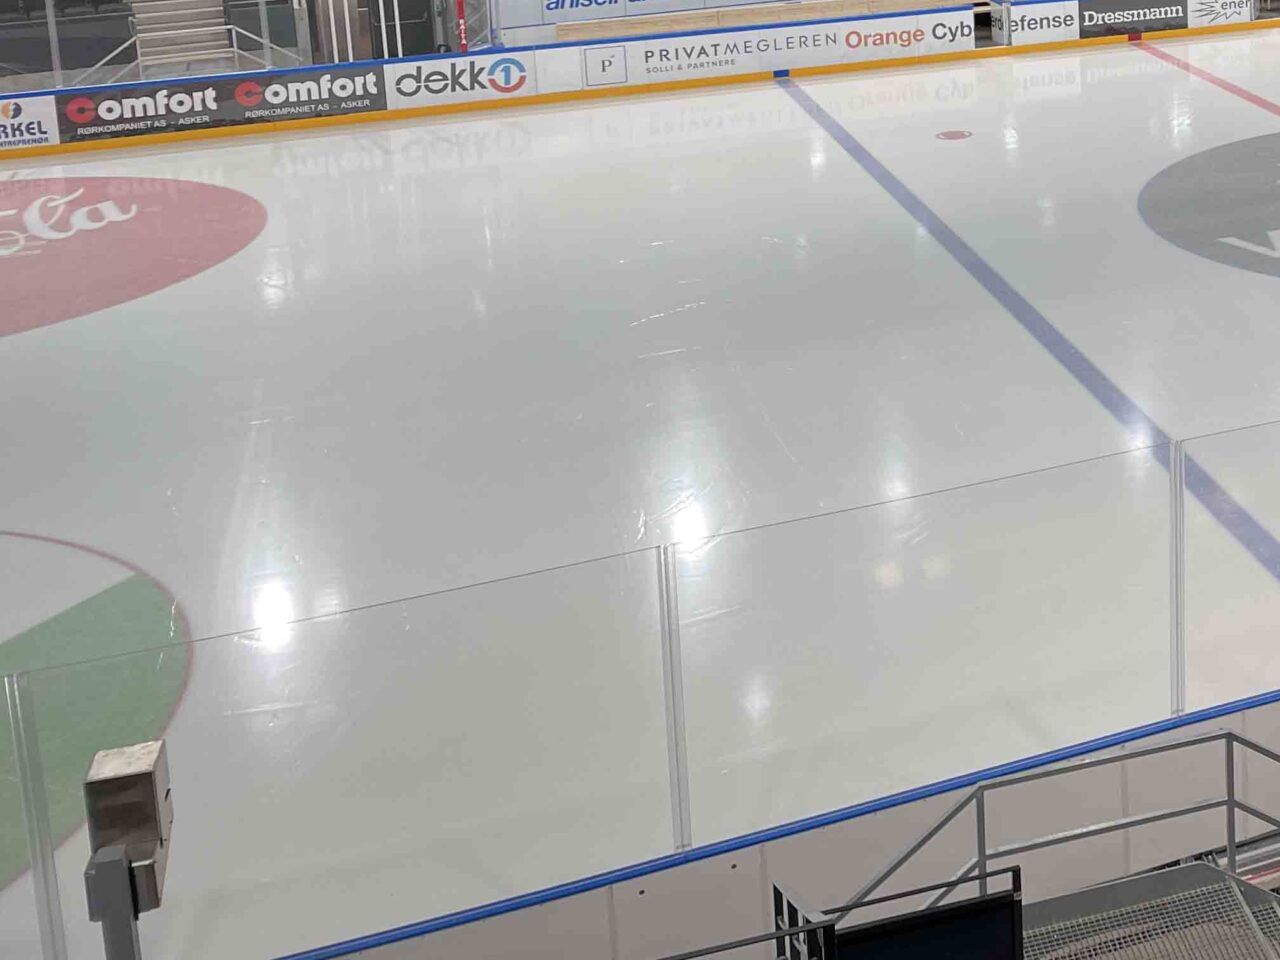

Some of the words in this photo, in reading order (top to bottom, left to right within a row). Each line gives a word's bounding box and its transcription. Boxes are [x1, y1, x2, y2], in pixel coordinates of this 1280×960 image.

[1083, 6, 1184, 26] Dressmann
[845, 28, 926, 49] Orange
[932, 21, 975, 42] Cyb
[644, 32, 837, 64] PRIVATMEGLEREN
[645, 65, 674, 74] SOLLI
[687, 58, 736, 70] PARTNERE
[244, 105, 316, 118] RØRKOMPANIET
[317, 104, 330, 112] AS
[340, 99, 370, 110] ASKER
[77, 120, 152, 135] RØRKOMPANIET
[153, 120, 166, 128] AS
[178, 115, 210, 126] ASKER
